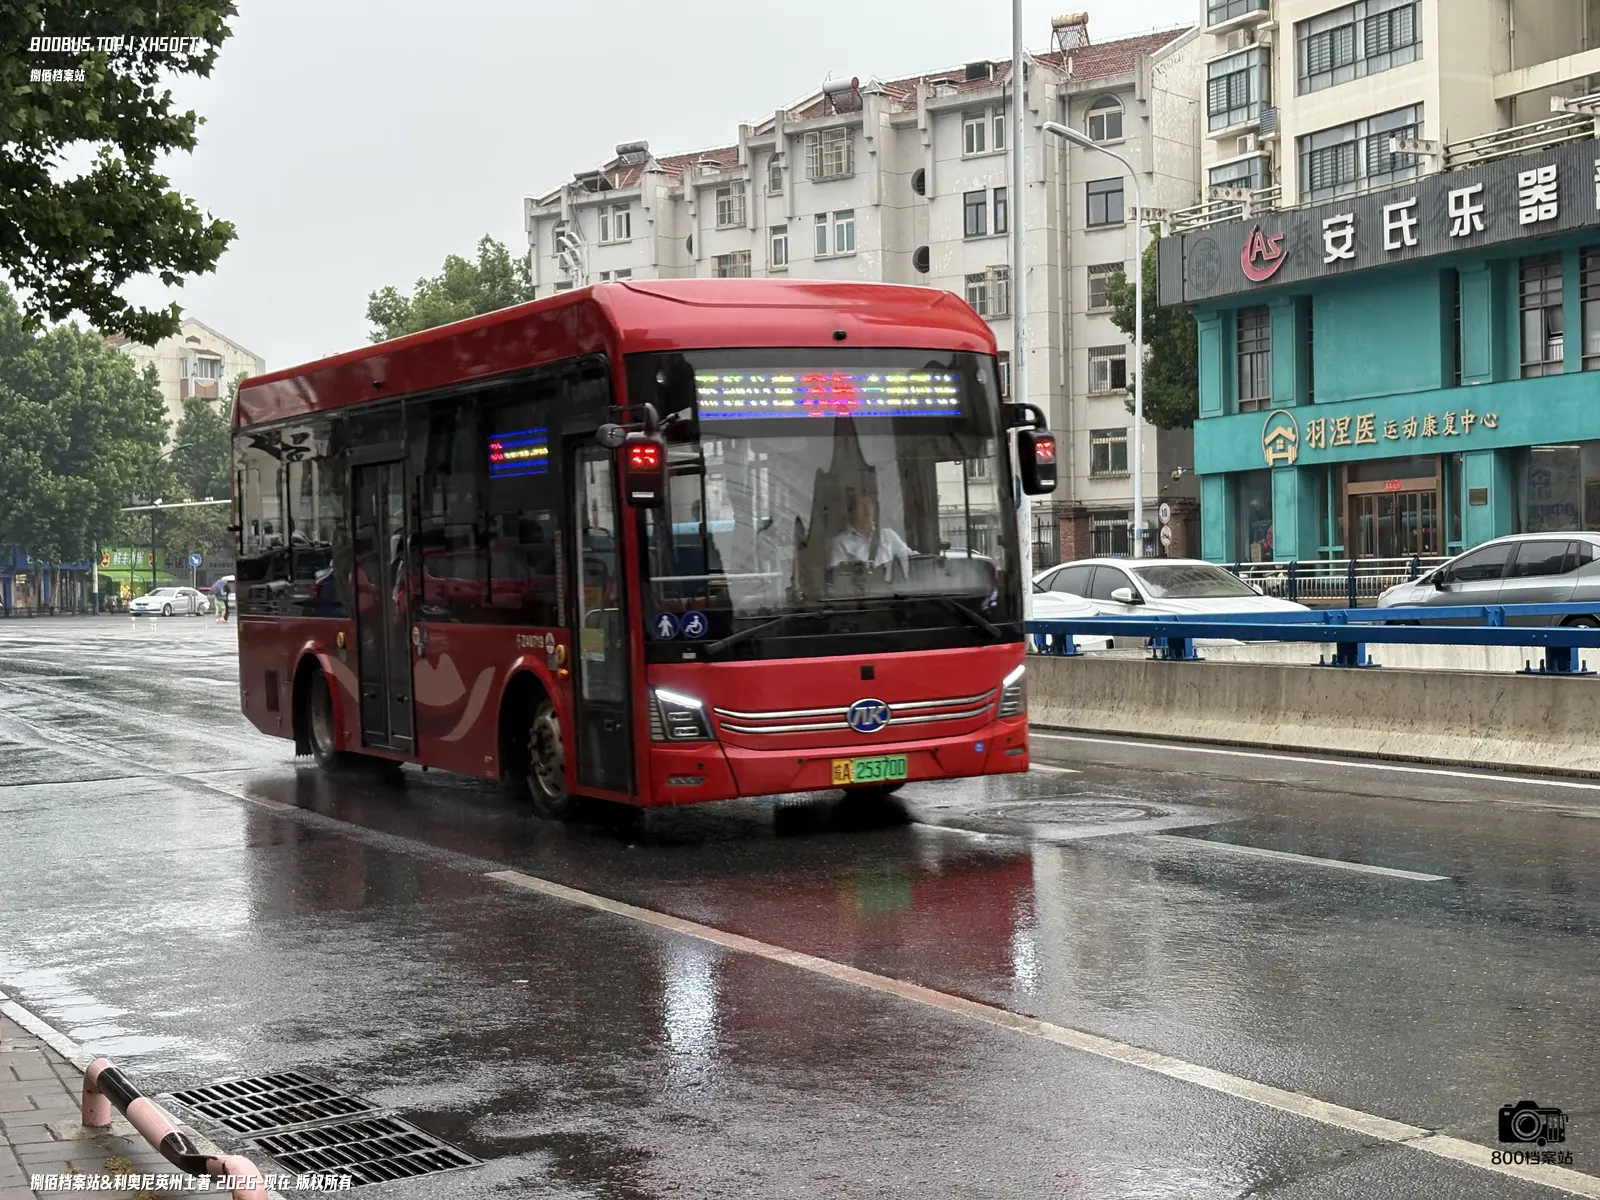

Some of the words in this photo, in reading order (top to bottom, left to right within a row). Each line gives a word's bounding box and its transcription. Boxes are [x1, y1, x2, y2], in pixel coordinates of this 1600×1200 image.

[1322, 158, 1600, 264] 安氏乐器
[1305, 413, 1377, 449] 羽涅医
[1383, 409, 1499, 440] 运动康复中心
